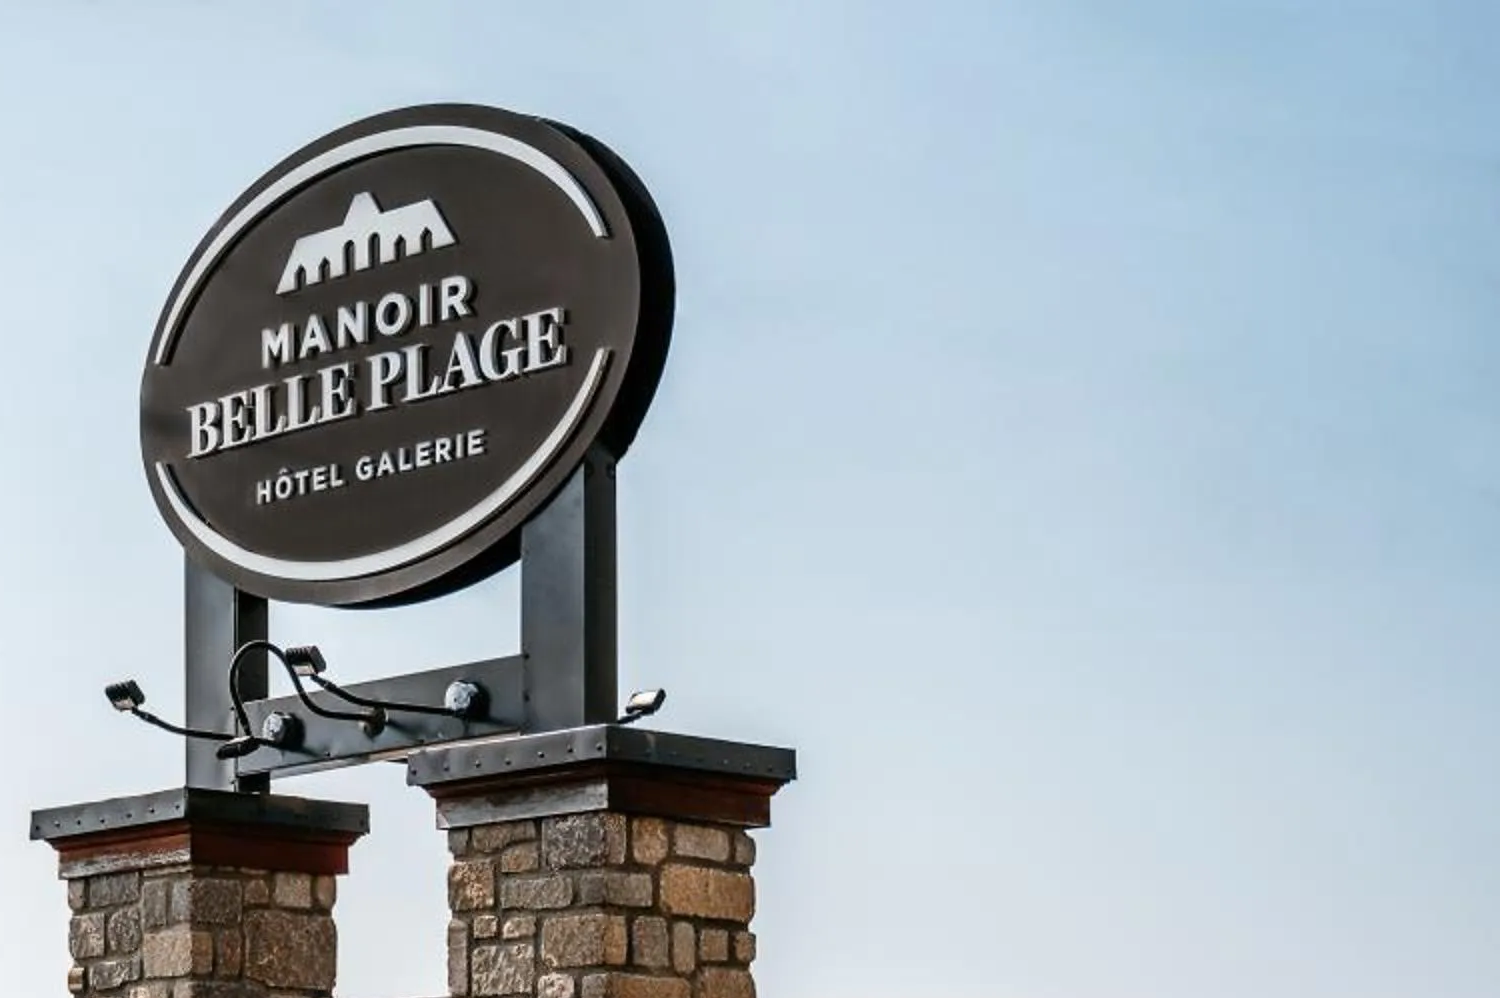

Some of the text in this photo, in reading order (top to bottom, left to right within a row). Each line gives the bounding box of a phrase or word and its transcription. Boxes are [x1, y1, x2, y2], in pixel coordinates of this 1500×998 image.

[261, 275, 473, 367] MANOIR
[186, 307, 568, 458] BELLE PLAGE
[256, 429, 486, 505] HÔTEL GALERIE
